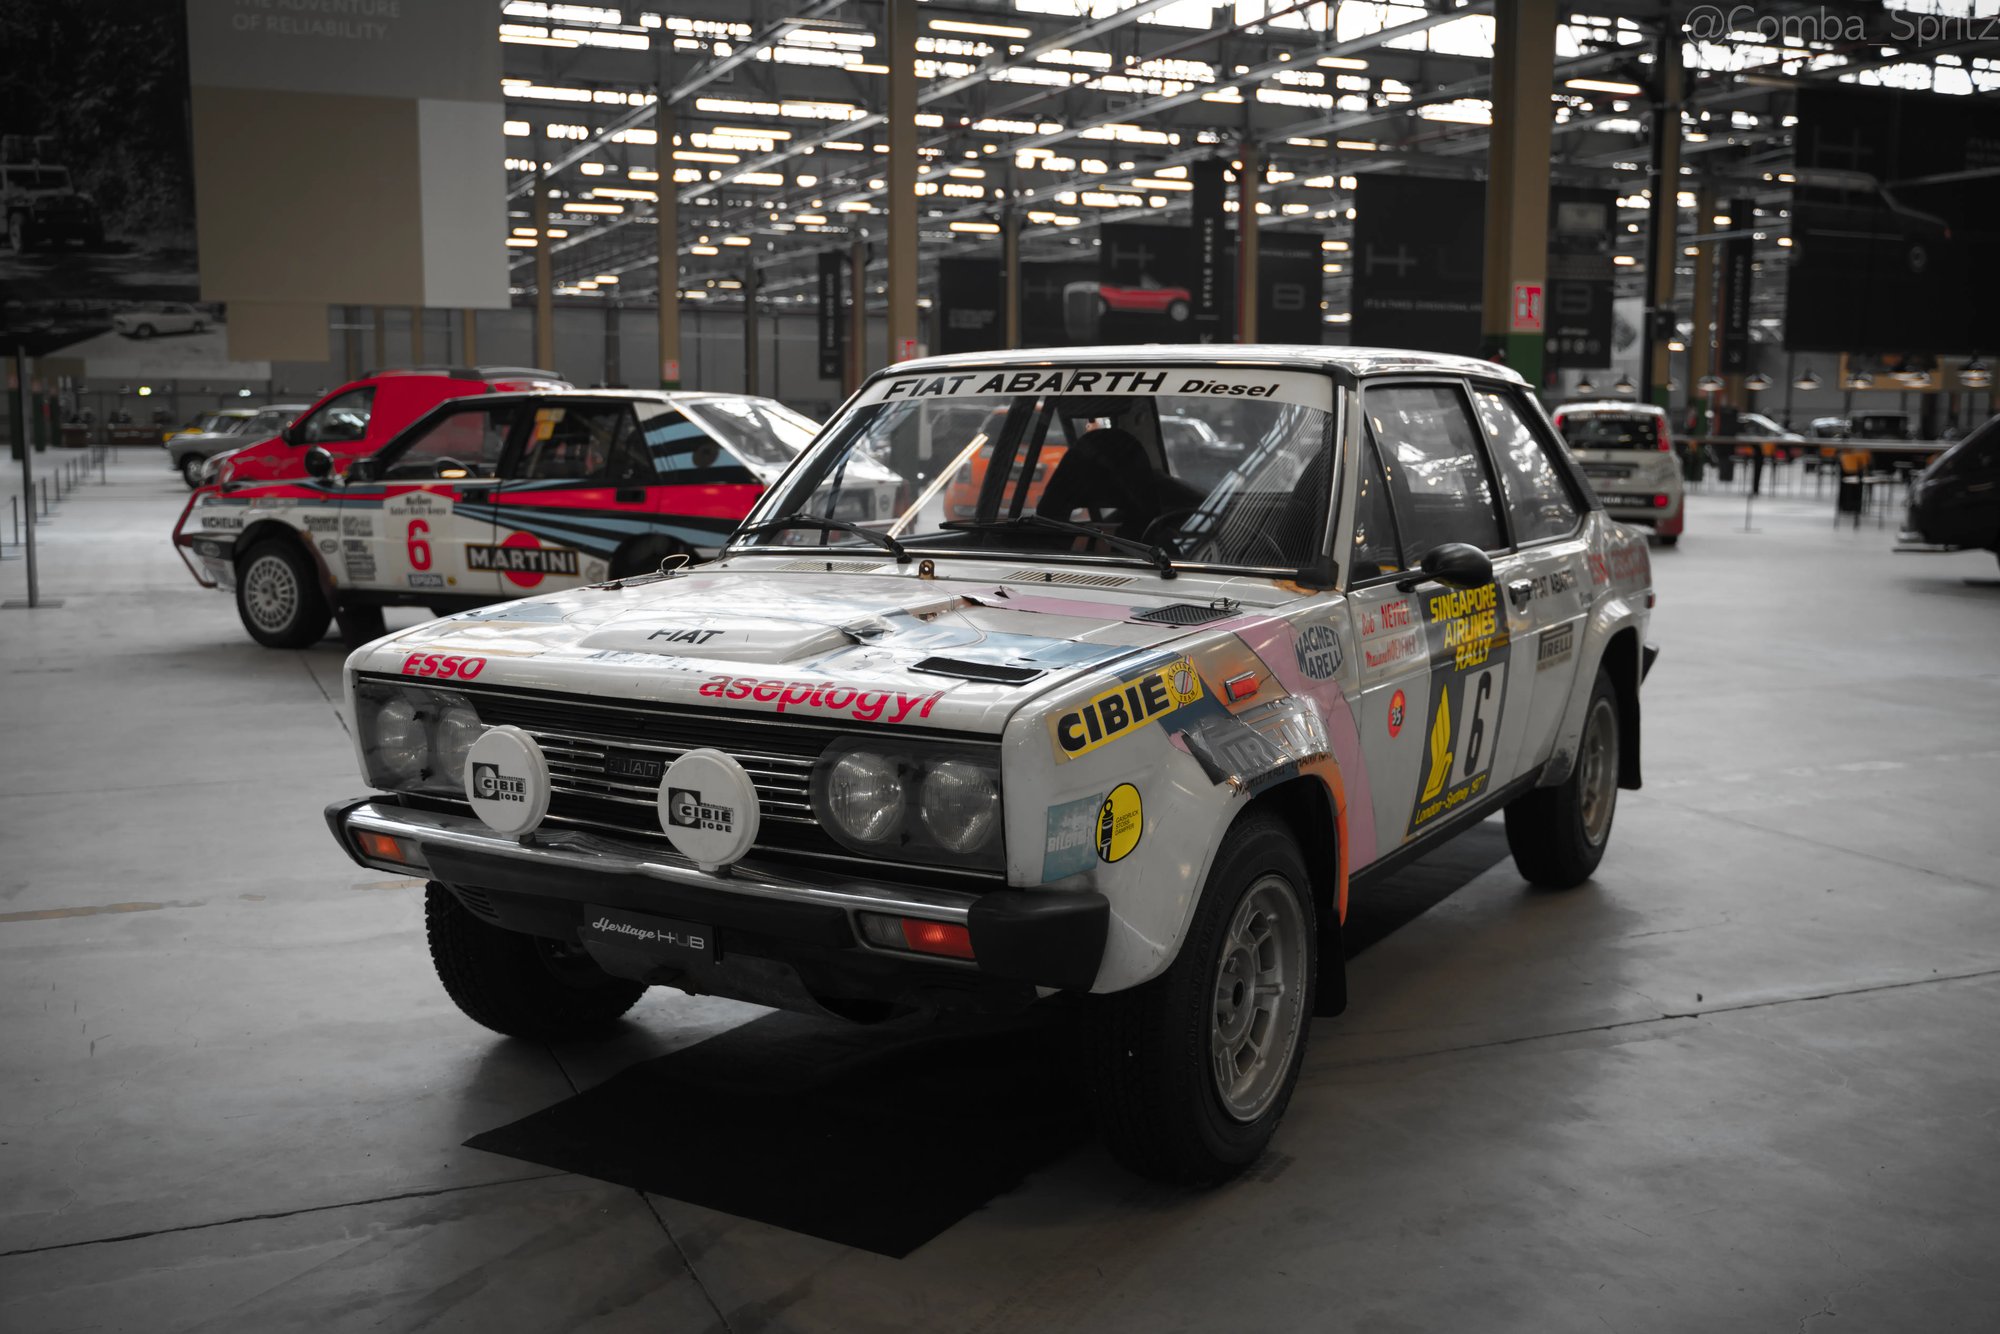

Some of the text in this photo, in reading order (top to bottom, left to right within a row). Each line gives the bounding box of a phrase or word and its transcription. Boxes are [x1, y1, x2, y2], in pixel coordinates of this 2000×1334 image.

[232, 13, 262, 31] OF
[883, 371, 1280, 401] FIAT ABARTH Diesel
[408, 518, 431, 571] 6
[469, 547, 576, 573] MARTINI
[1430, 583, 1497, 624] SINGAPORE
[647, 628, 725, 644] FIAT
[1444, 609, 1496, 649] AIRLINES
[1539, 622, 1573, 662] PIRELLI
[401, 652, 487, 680] ESSO
[1455, 637, 1492, 672] RALLY
[698, 675, 945, 723] aseptogyl
[1180, 690, 1196, 702] TEAM
[1464, 671, 1491, 777] 6
[501, 792, 525, 802] IODE
[702, 821, 732, 833] IODE
[592, 917, 705, 950] Heritage HUB
